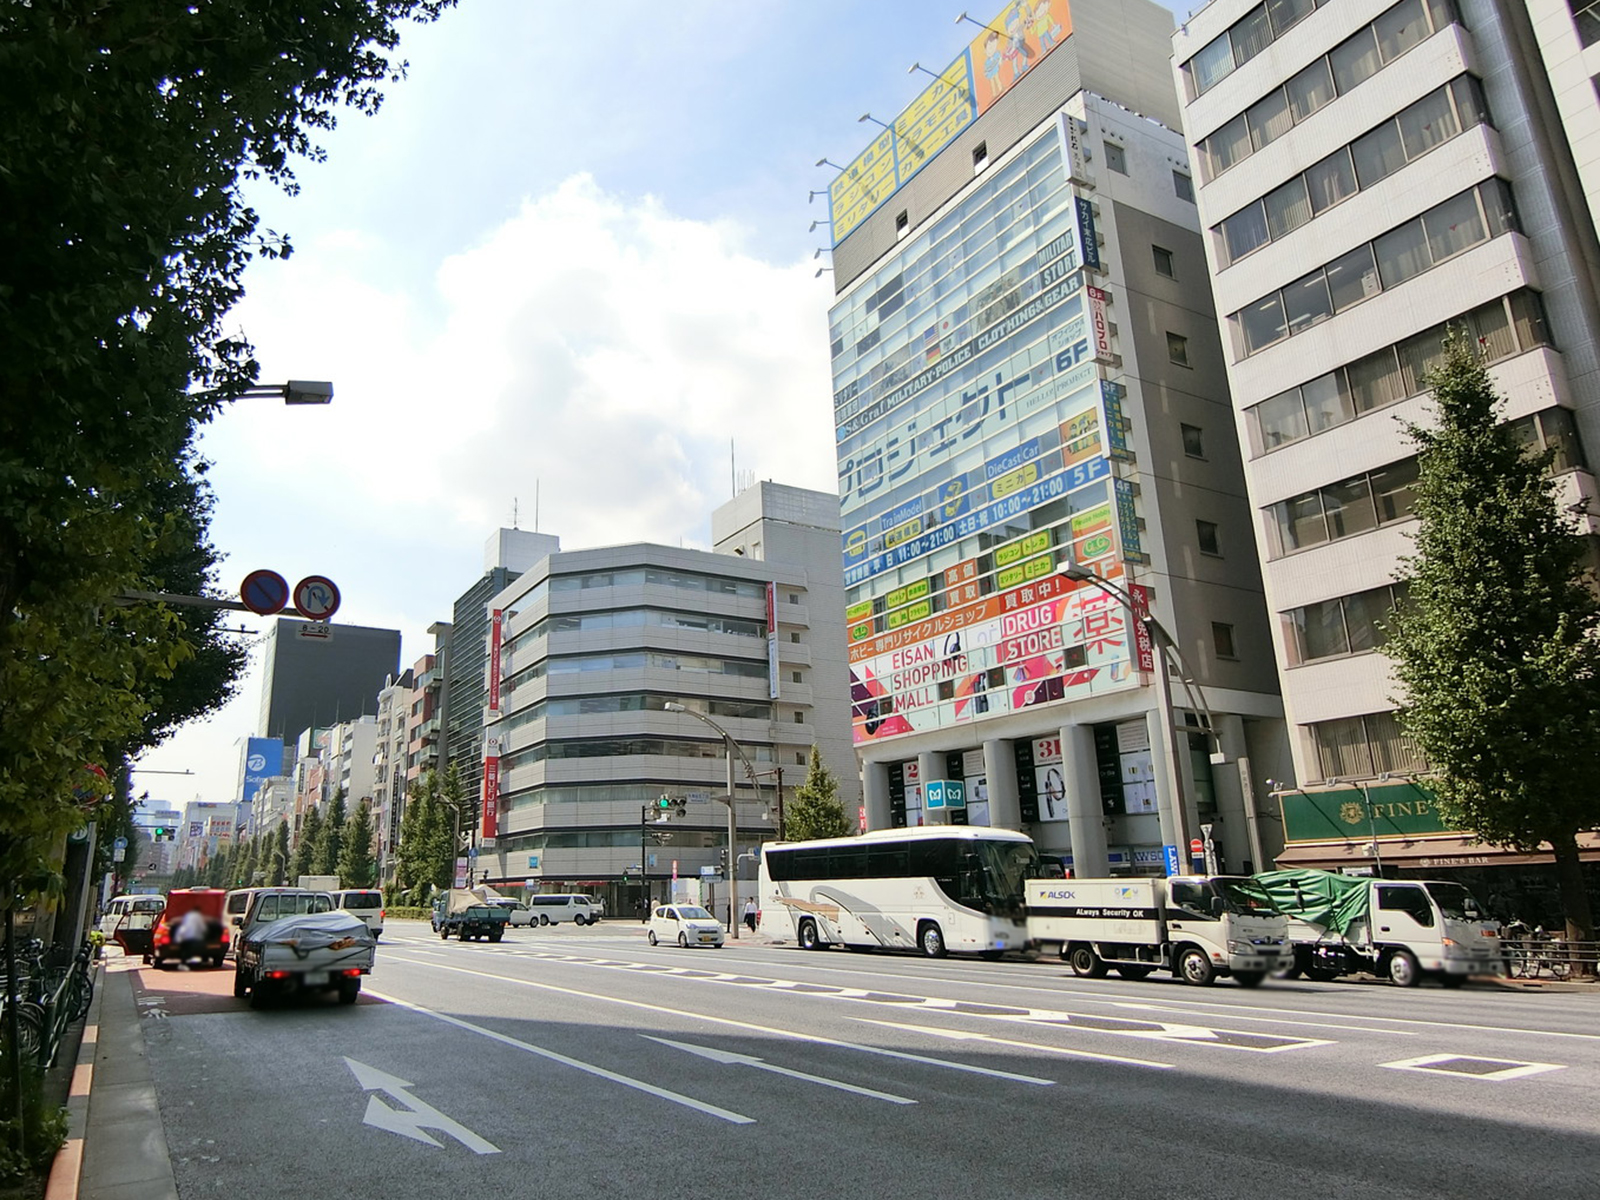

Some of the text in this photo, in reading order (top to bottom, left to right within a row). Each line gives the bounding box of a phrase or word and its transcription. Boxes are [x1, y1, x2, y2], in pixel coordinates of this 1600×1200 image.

[1044, 253, 1077, 285] STORE
[1089, 288, 1103, 299] 6F
[1055, 337, 1088, 374] 6F
[1056, 366, 1092, 392] PROJECT
[1102, 381, 1117, 393] 5F
[838, 373, 1031, 508] プロジェクト
[1022, 444, 1040, 460] Car
[996, 470, 1035, 493] ミニカー
[1116, 480, 1131, 492] 4F
[948, 562, 974, 584] 高価
[949, 584, 976, 606] 買取
[1005, 605, 1052, 636] DRUG
[1007, 627, 1063, 660] STORE
[892, 644, 934, 670] EISAN
[893, 654, 968, 691] SHOPPING
[894, 687, 934, 713] MALL
[1373, 800, 1430, 819] FINE
[1433, 856, 1489, 866] FINE'S BAR
[1047, 890, 1076, 900] ALSOK
[1102, 908, 1131, 919] Security
[1132, 910, 1144, 918] OK
